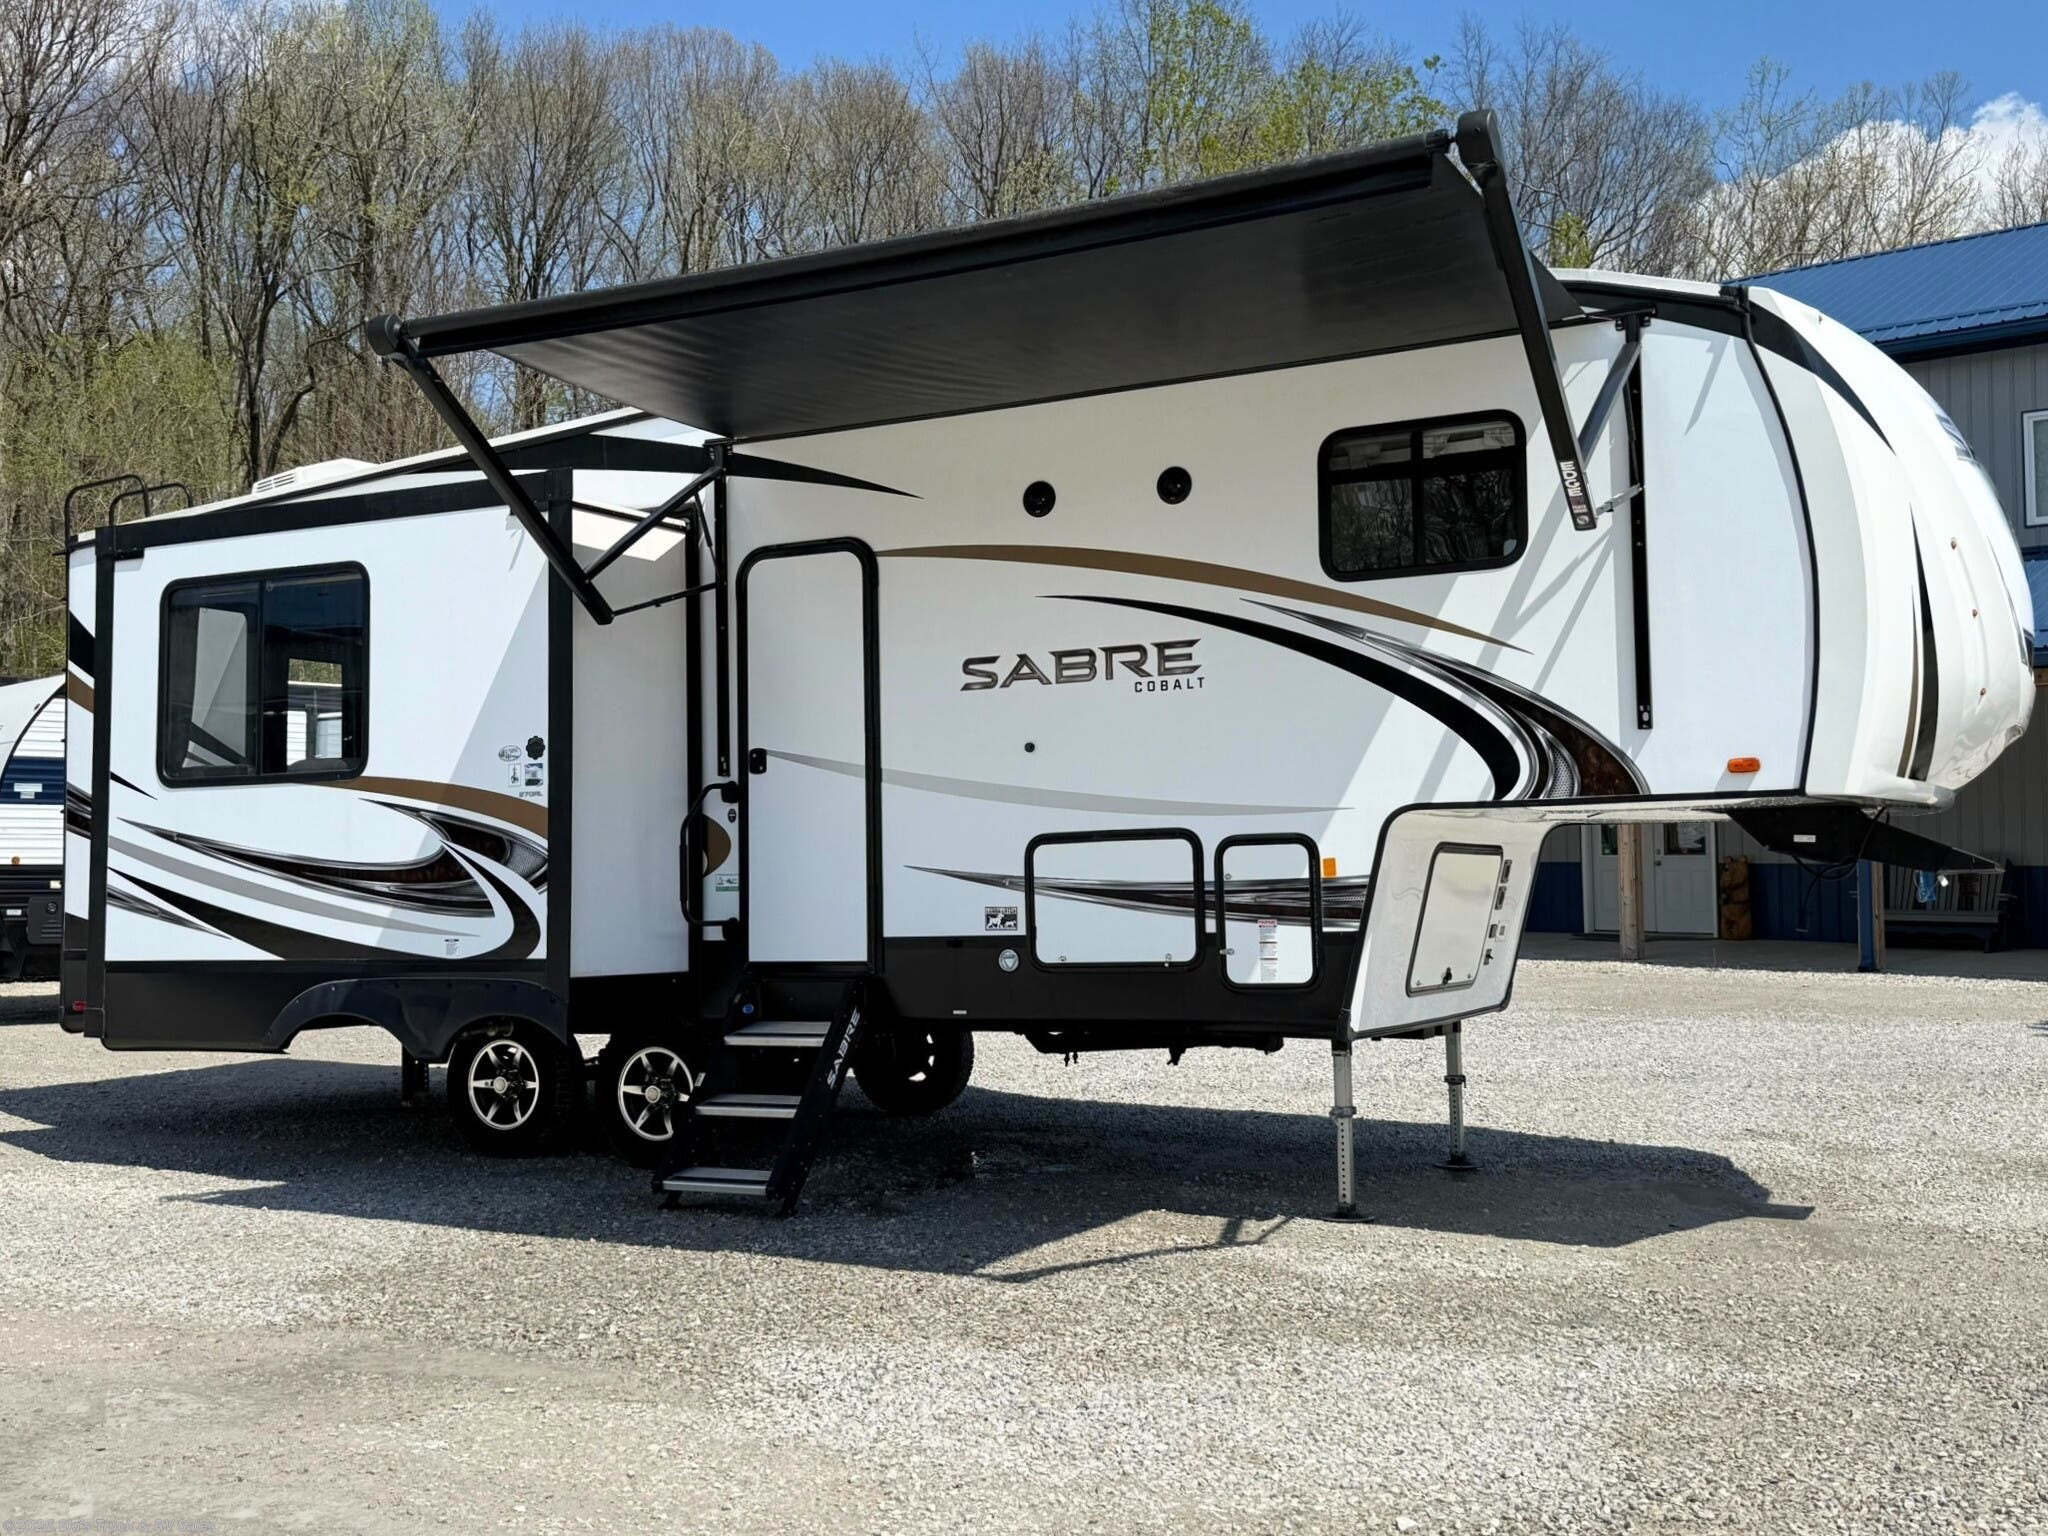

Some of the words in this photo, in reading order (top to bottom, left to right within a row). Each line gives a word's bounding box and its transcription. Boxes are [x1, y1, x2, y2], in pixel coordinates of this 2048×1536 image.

[960, 638, 1202, 691] SABRE
[1134, 677, 1205, 693] COBALT
[827, 1007, 860, 1090] SABRE
